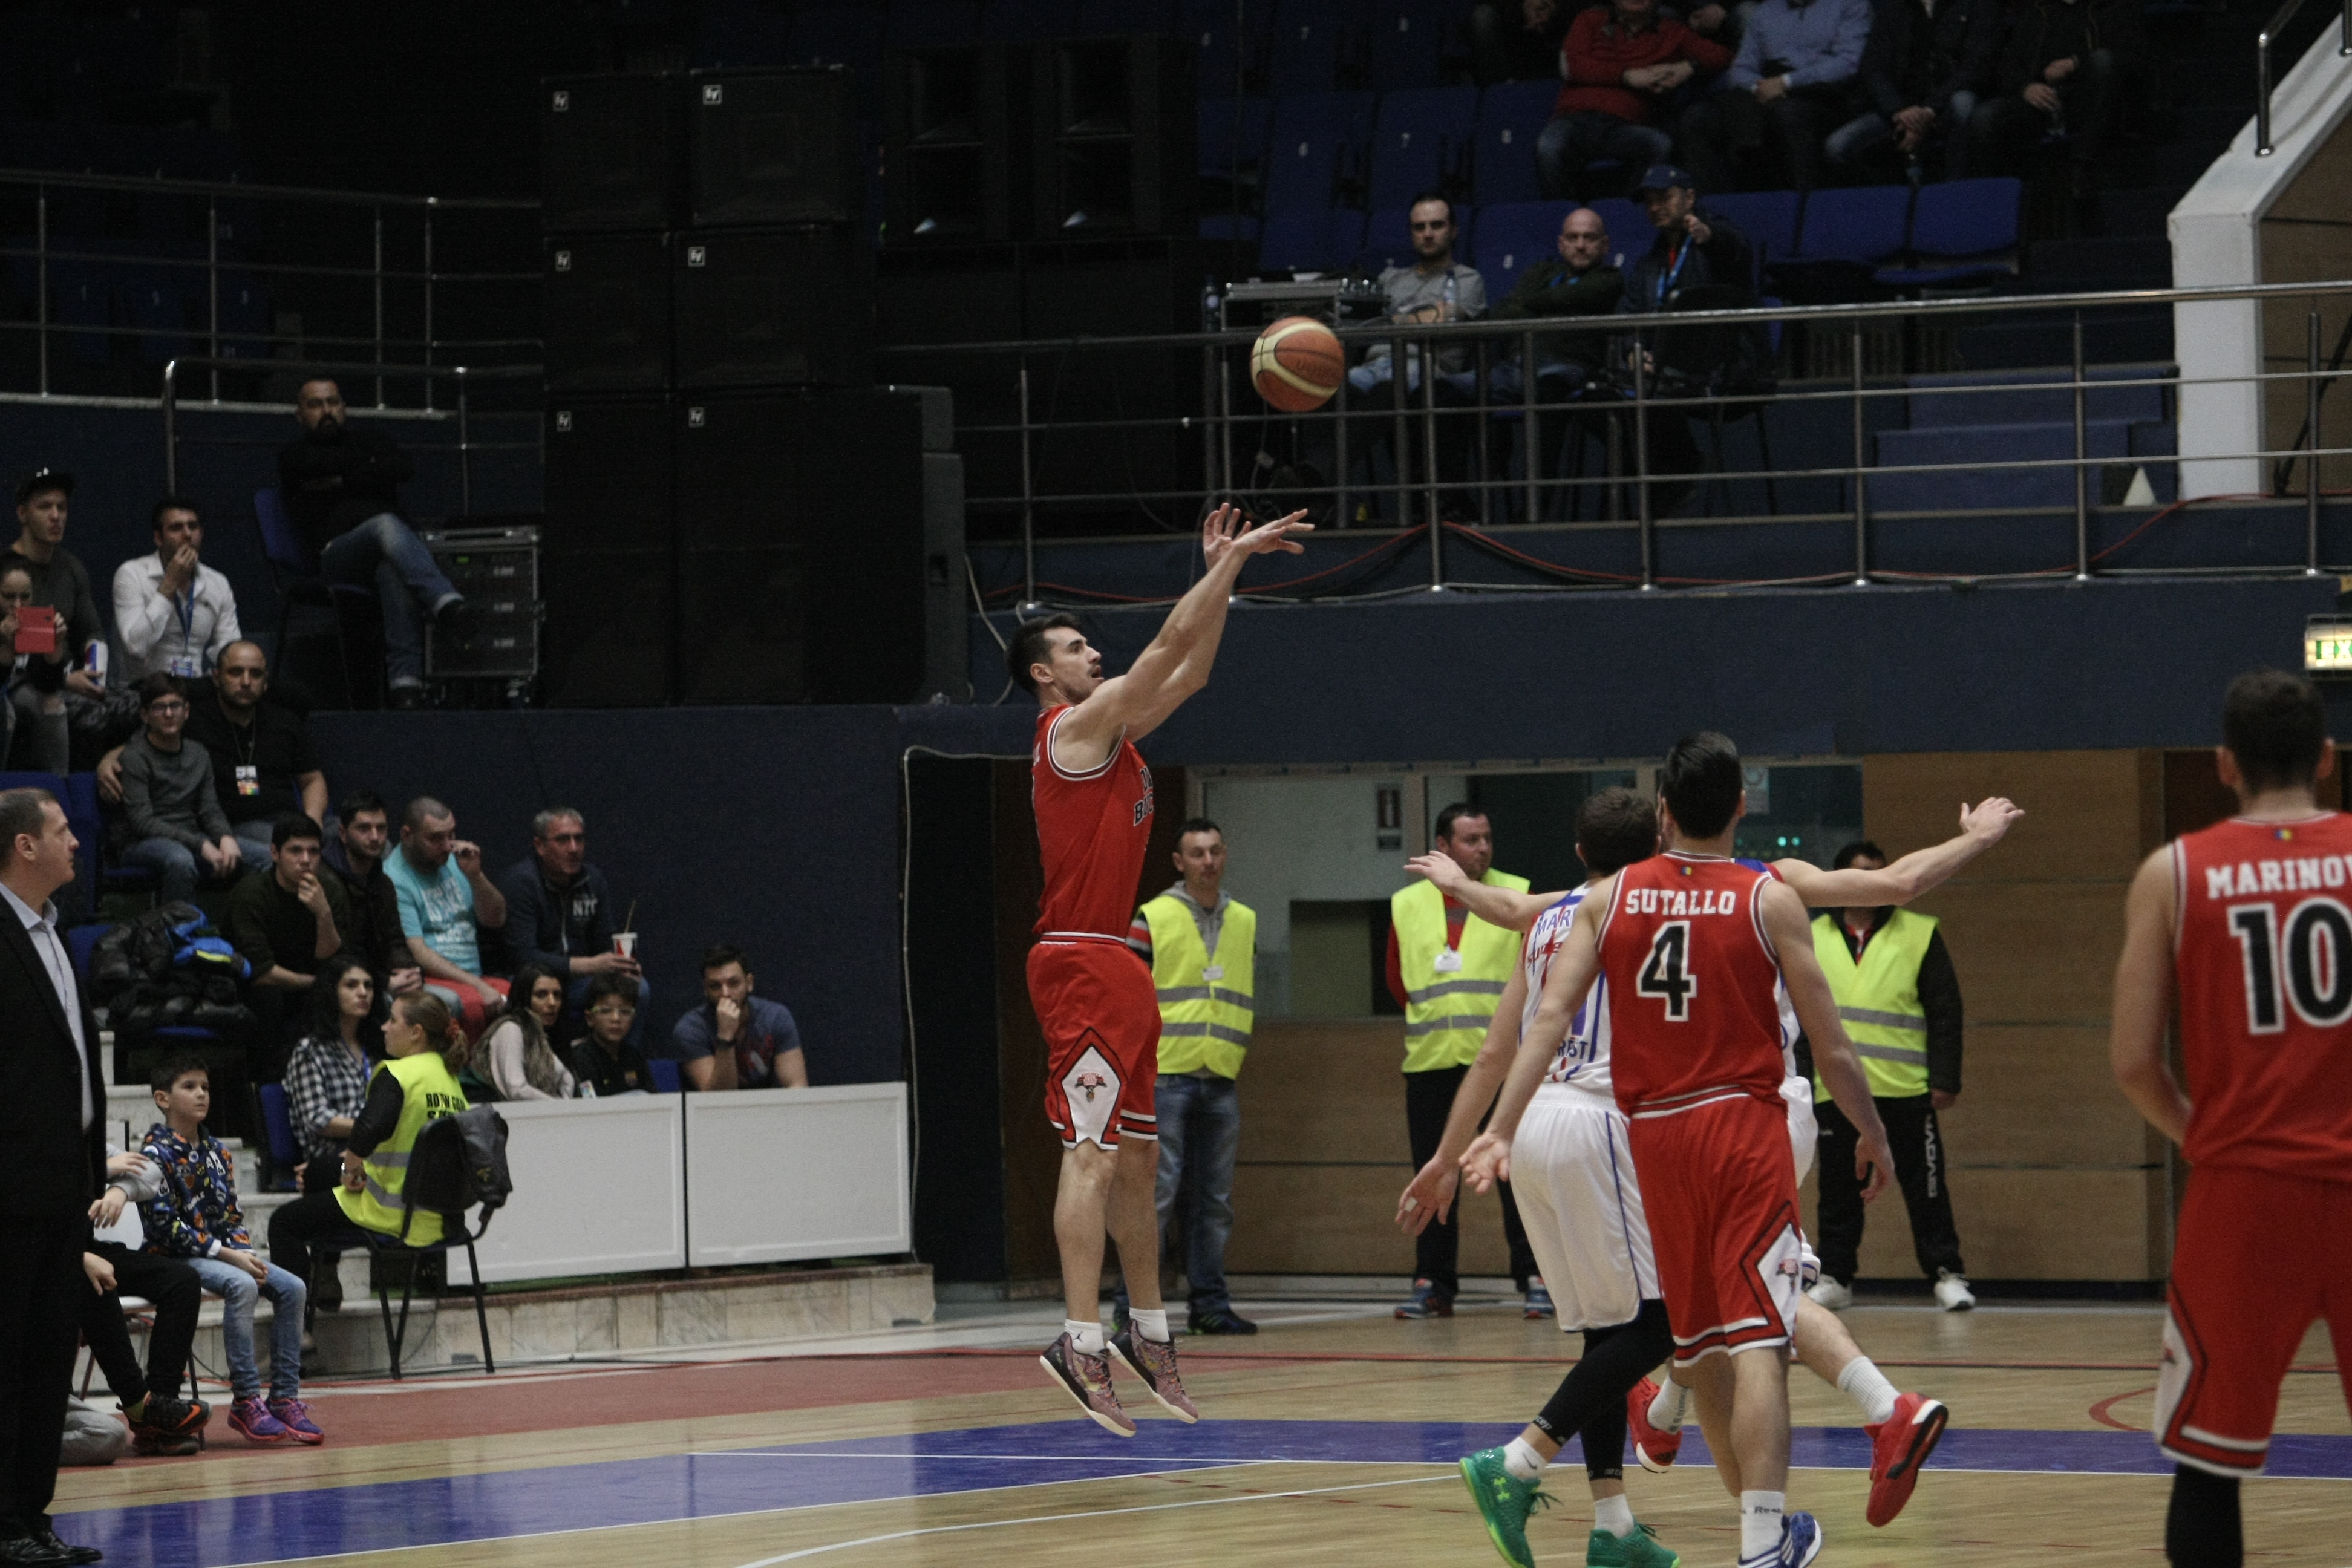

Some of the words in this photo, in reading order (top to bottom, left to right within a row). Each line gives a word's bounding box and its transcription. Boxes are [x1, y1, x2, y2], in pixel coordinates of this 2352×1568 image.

[1625, 889, 1736, 915] SUTALLO
[1636, 920, 1697, 1022] 4
[2226, 896, 2352, 1036] 10
